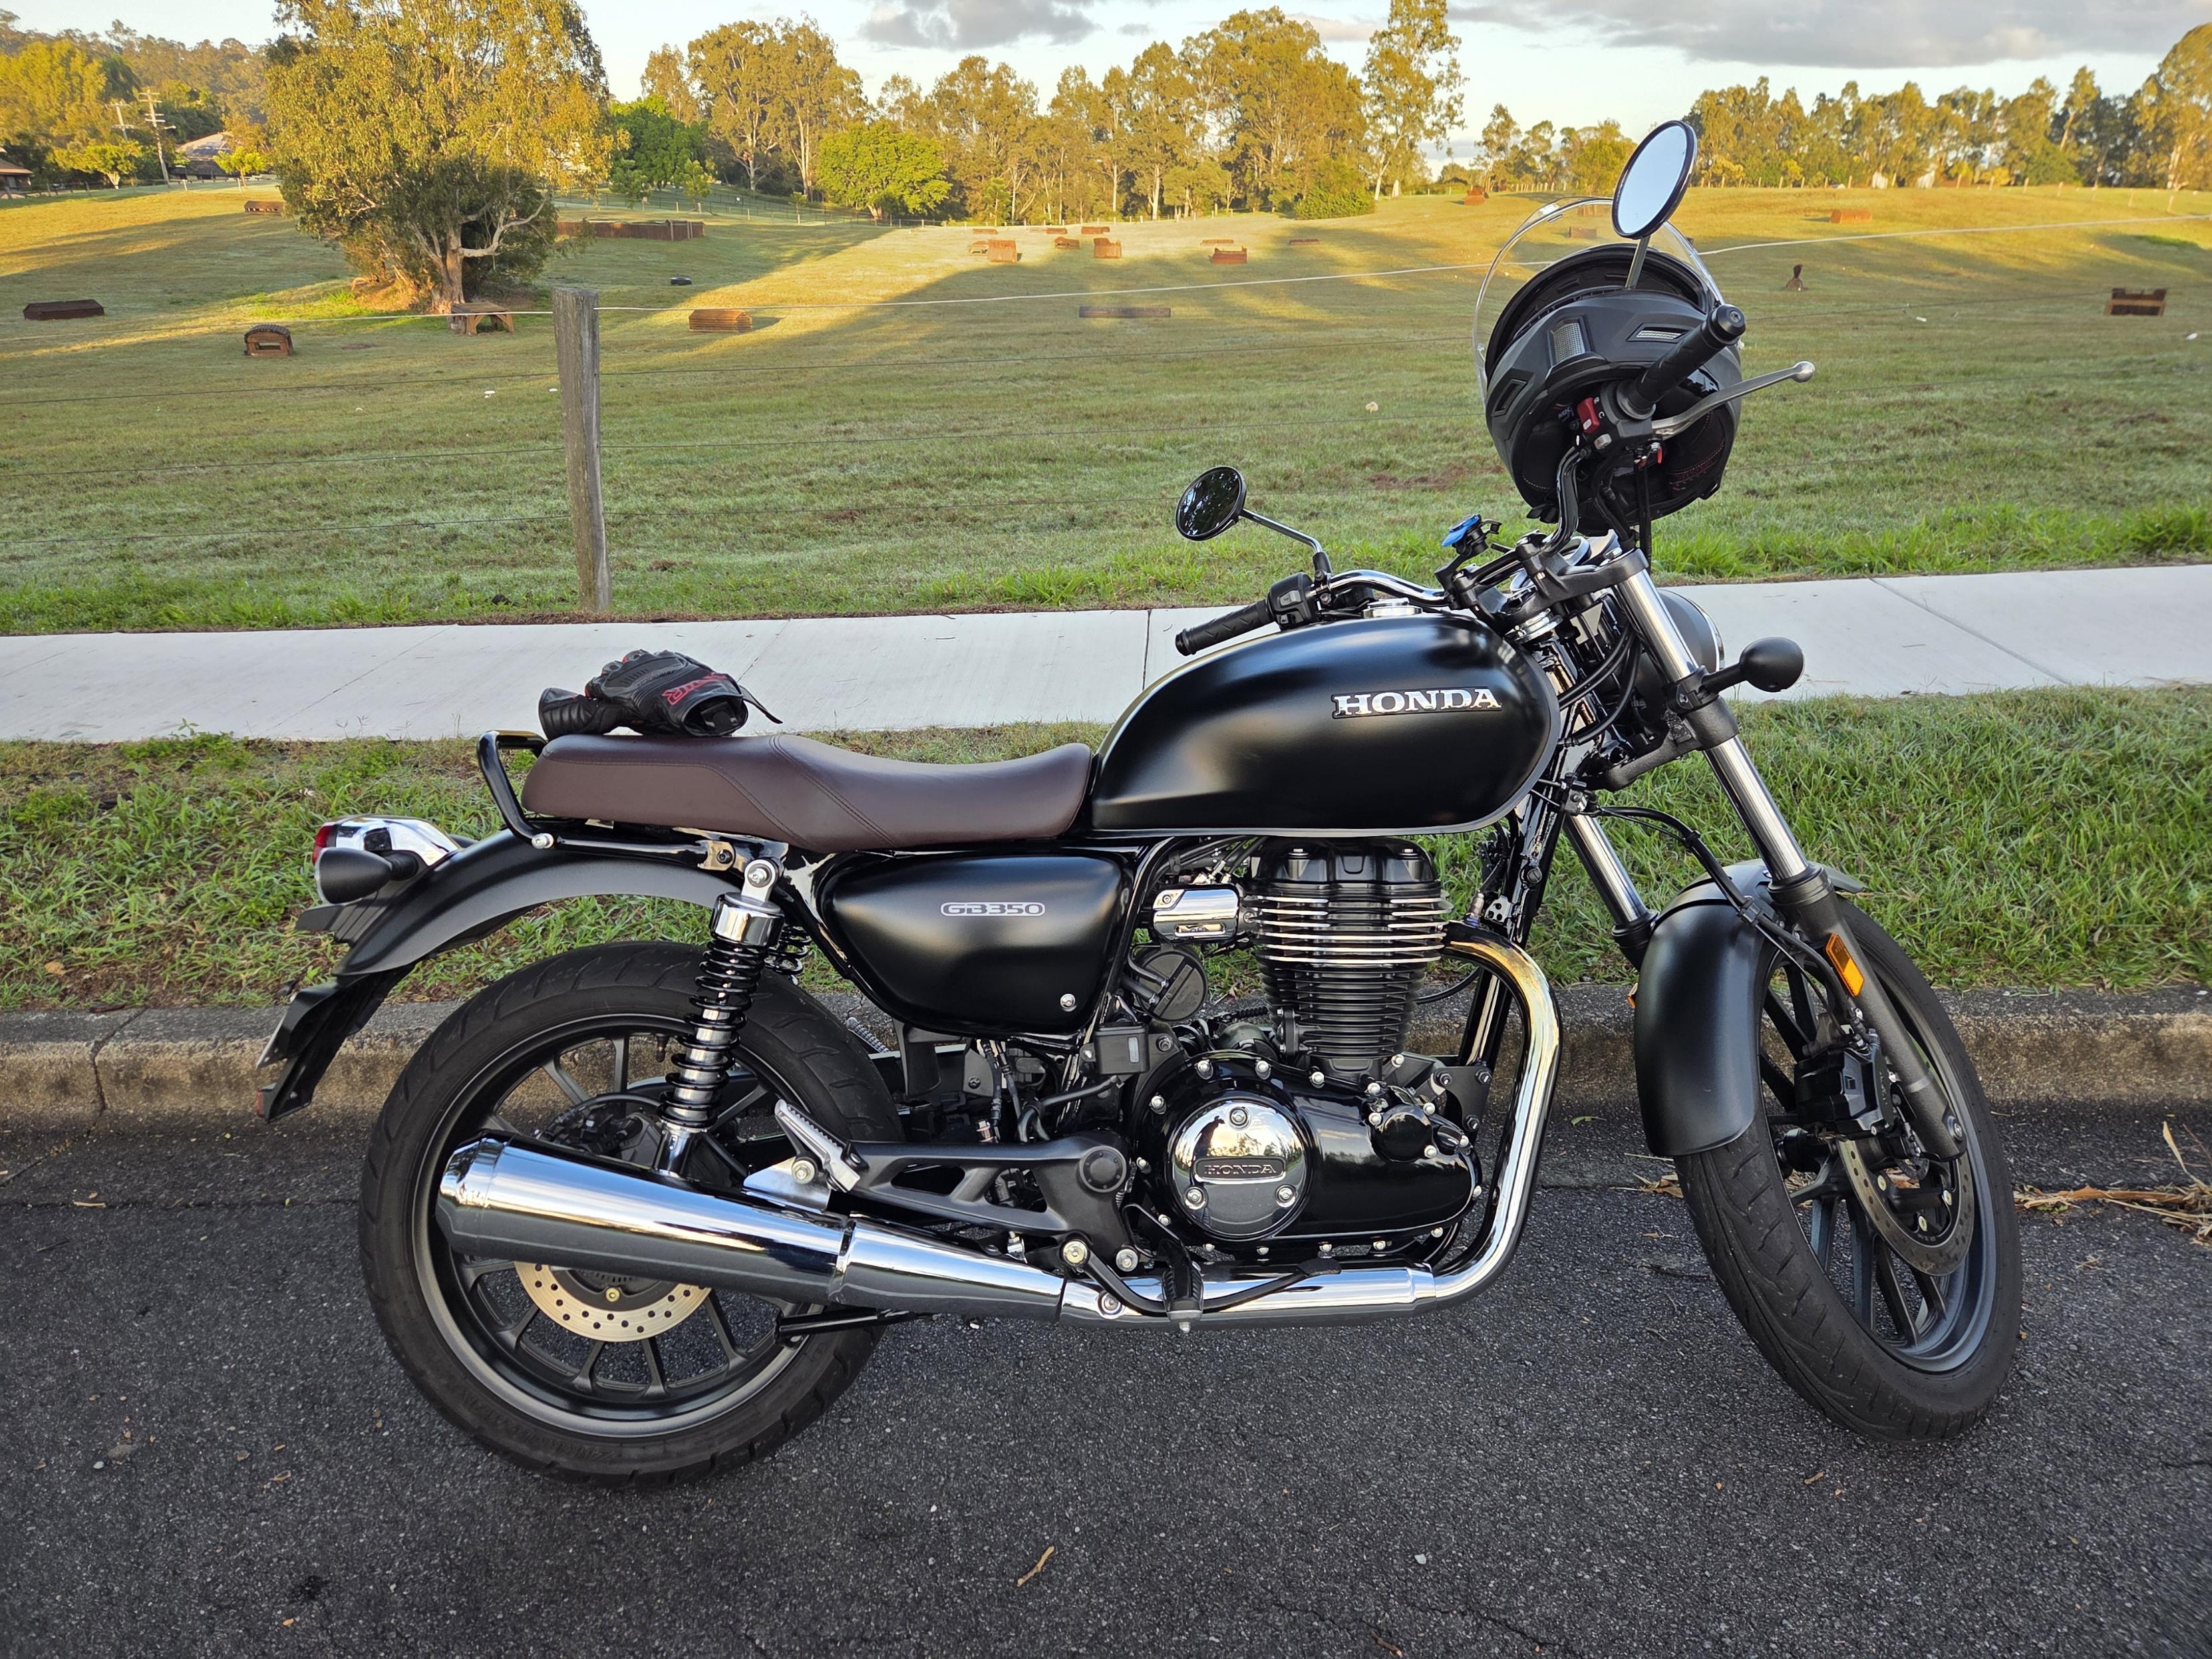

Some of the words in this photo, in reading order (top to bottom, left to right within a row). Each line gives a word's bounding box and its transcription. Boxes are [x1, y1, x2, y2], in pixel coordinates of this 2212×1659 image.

[1333, 688, 1502, 716] HONDA
[942, 903, 1044, 915] GB350
[1204, 1164, 1277, 1175] HONDA
